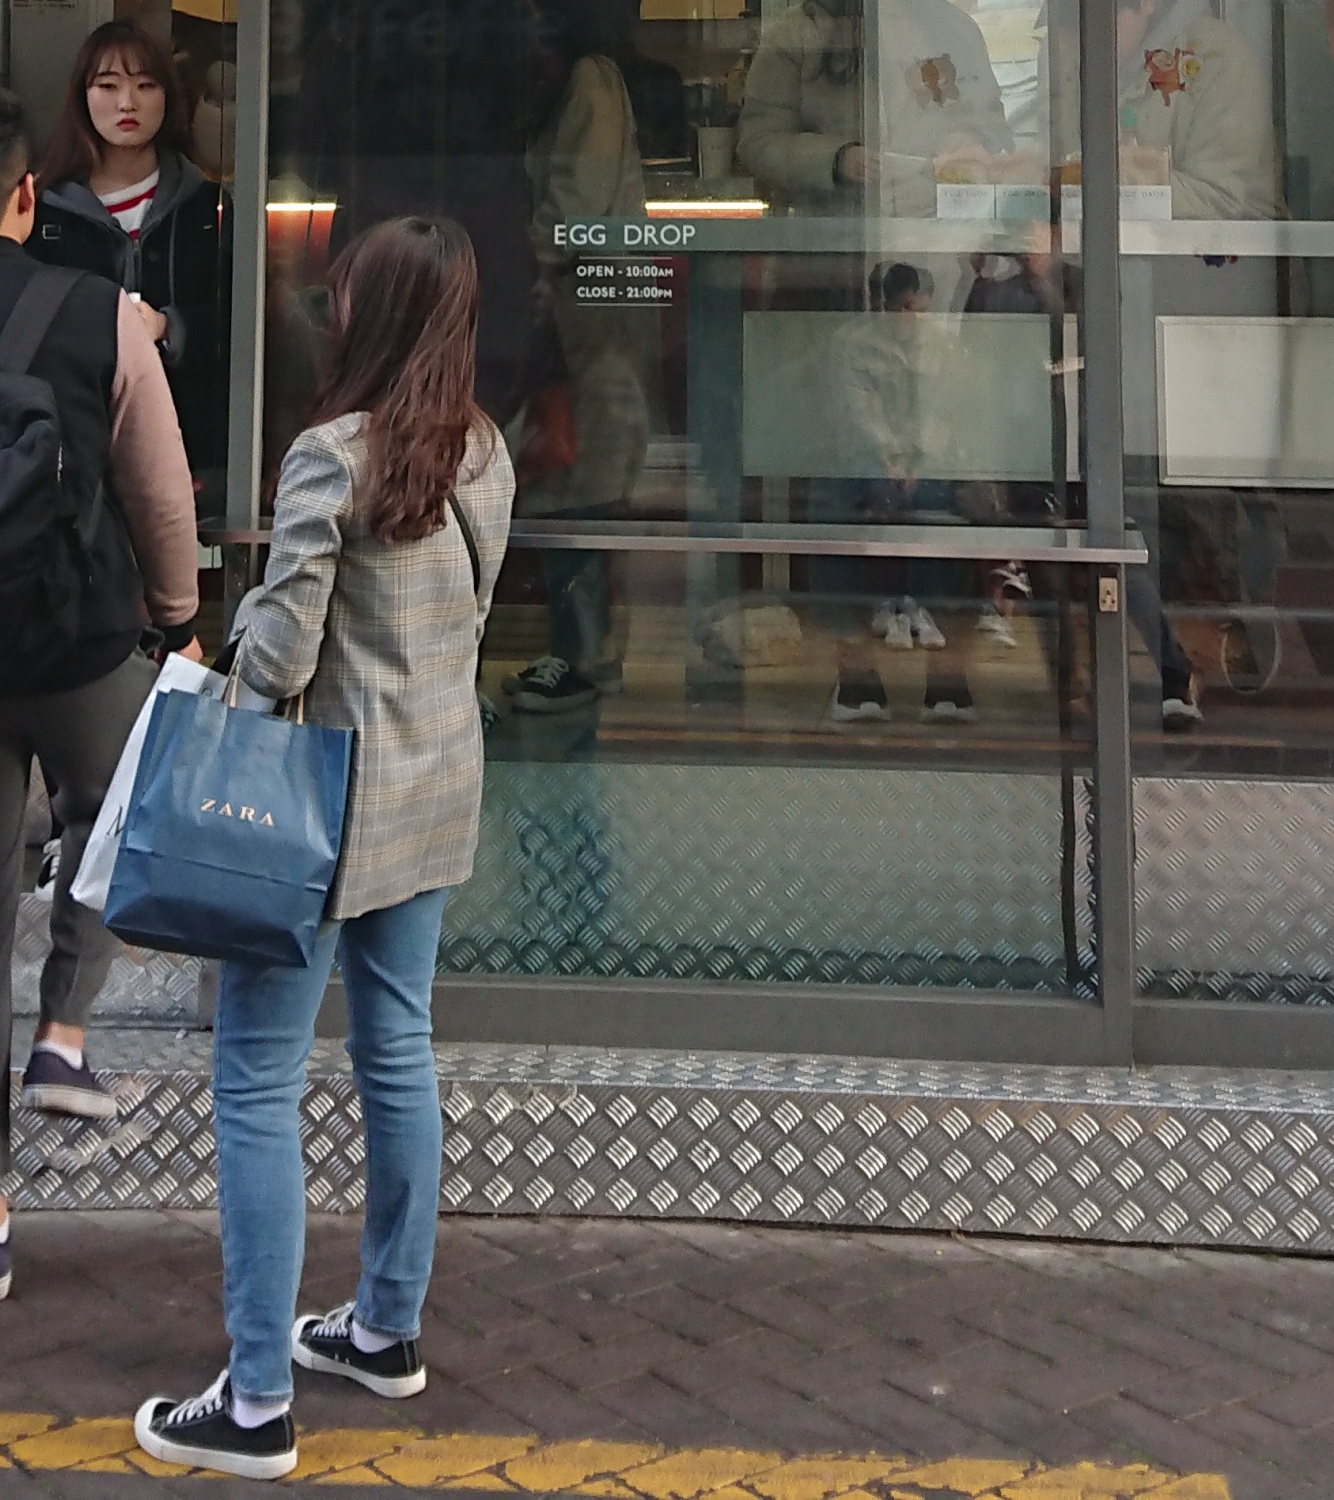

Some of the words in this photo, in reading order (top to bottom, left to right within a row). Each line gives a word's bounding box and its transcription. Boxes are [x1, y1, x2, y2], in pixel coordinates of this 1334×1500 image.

[553, 224, 606, 245] EGG
[623, 224, 696, 245] DROP
[576, 265, 614, 277] OPEN
[625, 265, 674, 277] 10:00AM
[576, 286, 616, 298] CLOSE
[626, 286, 673, 299] 21:00PM
[200, 798, 275, 827] ZARA
